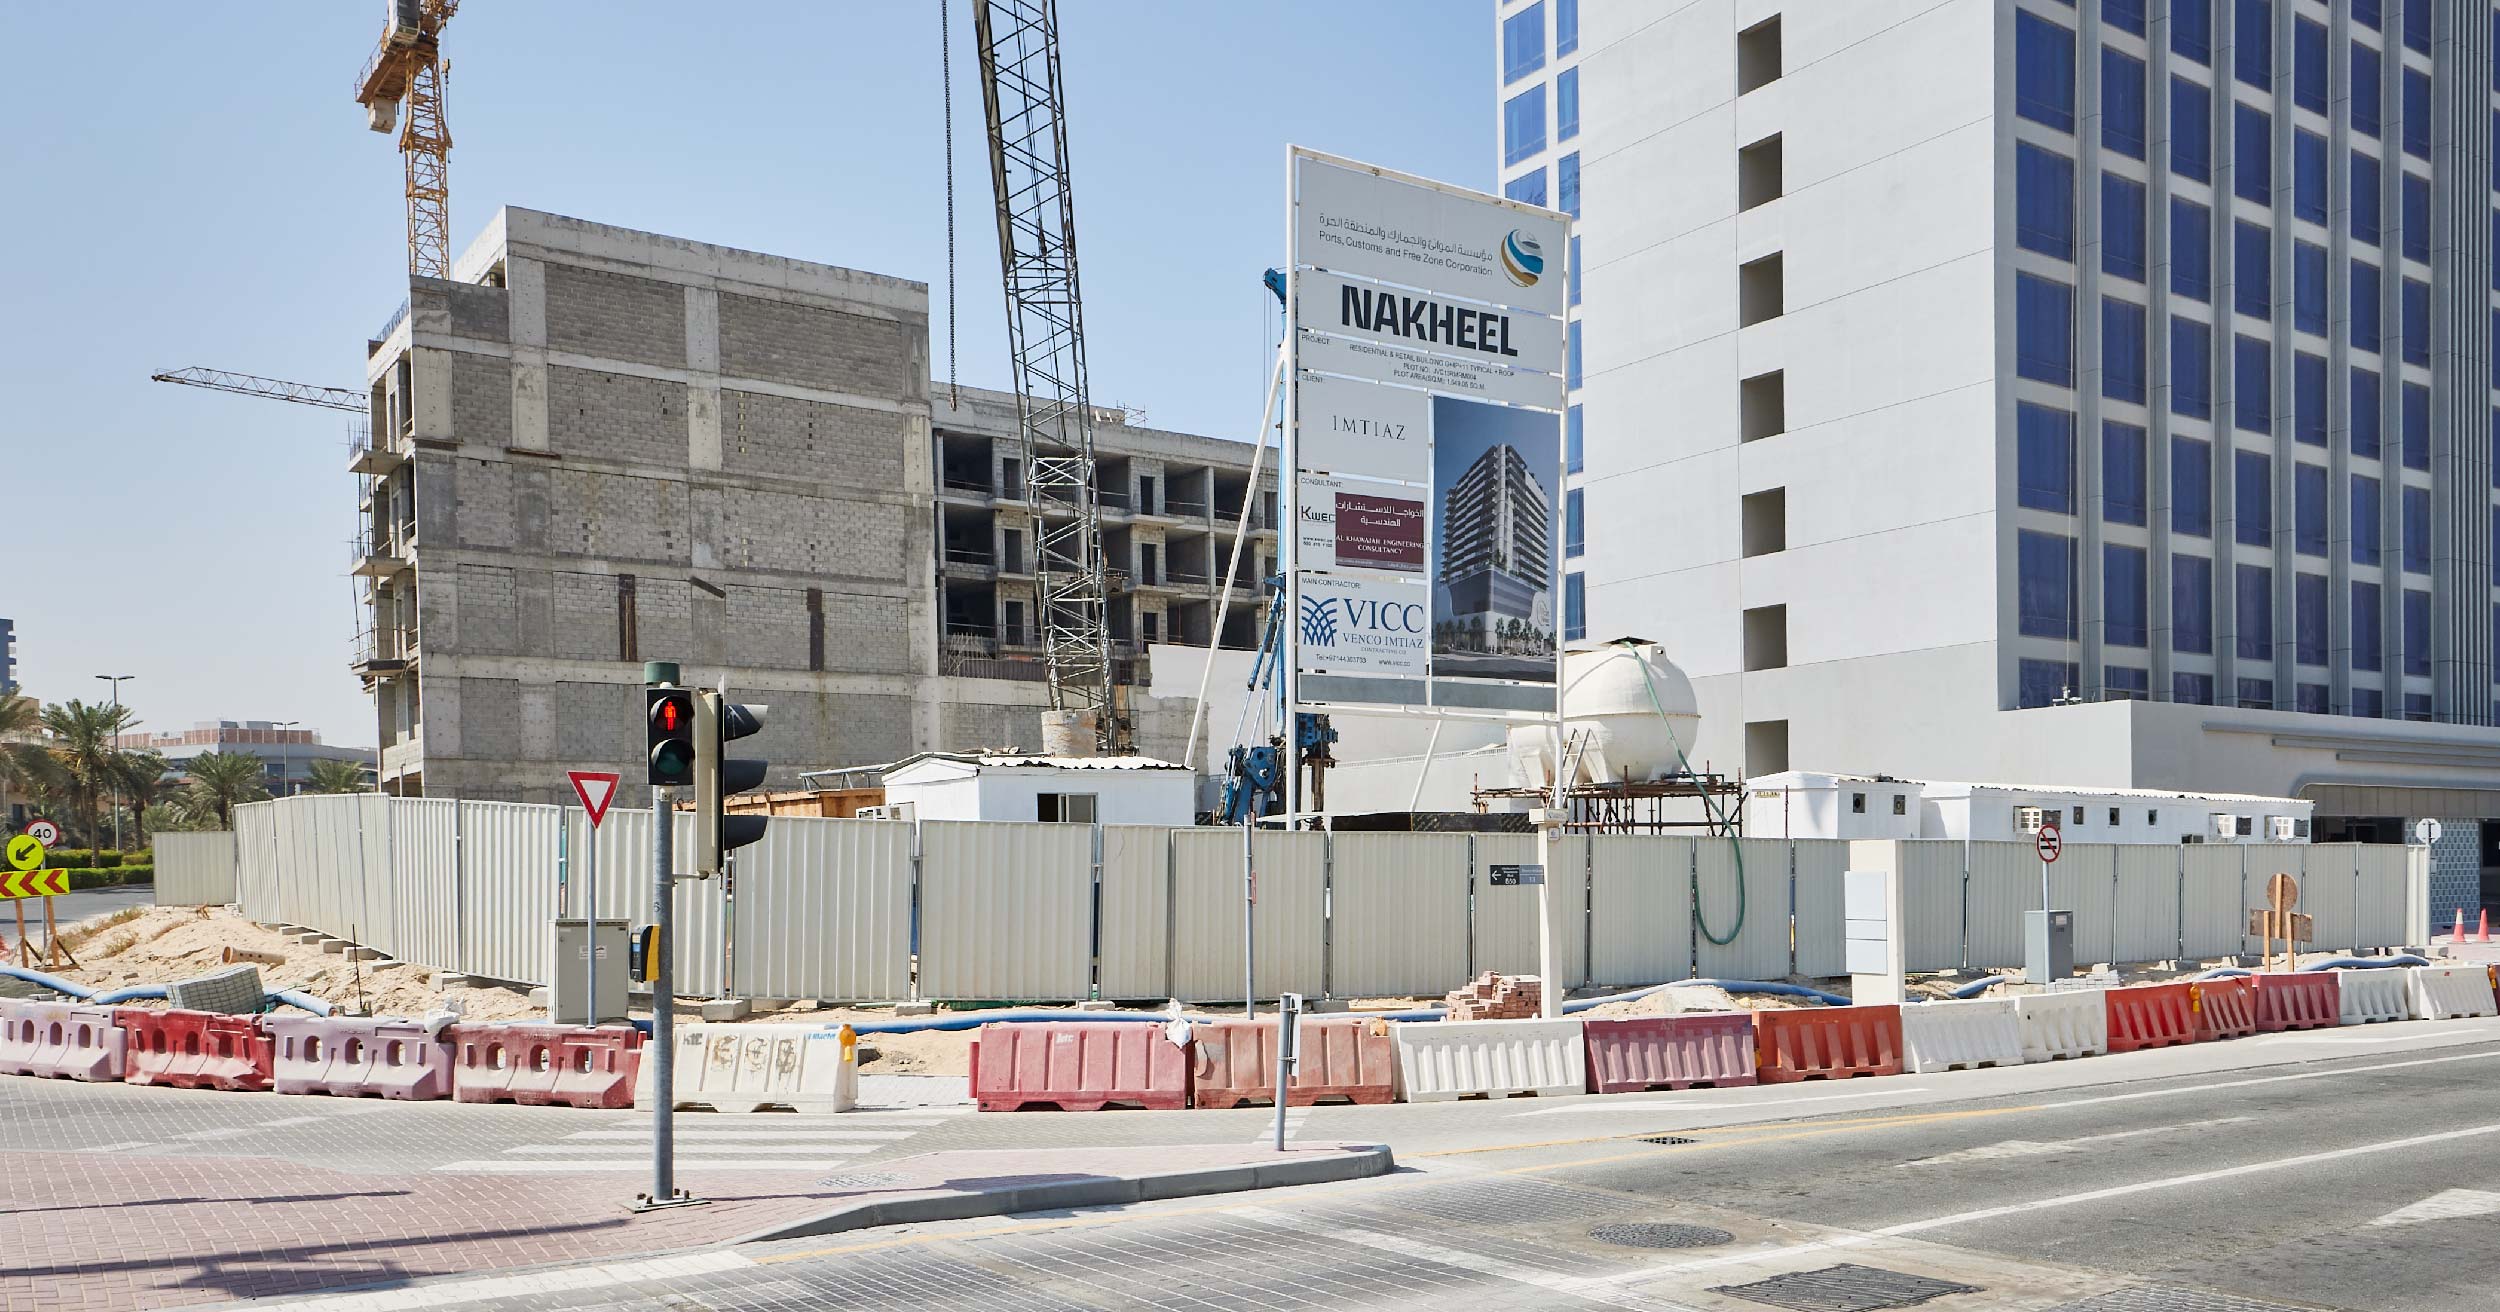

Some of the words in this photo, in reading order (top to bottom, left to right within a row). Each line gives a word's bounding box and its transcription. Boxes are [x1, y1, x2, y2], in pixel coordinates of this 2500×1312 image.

[1319, 212, 1343, 228] الحرة
[1344, 218, 1386, 240] والمنطقة
[1387, 229, 1427, 251] والجمارك
[1319, 230, 1345, 246] Ports,
[1346, 236, 1383, 254] Customs
[1385, 245, 1401, 258] and
[1403, 249, 1421, 263] Free
[1423, 254, 1444, 268] Zone
[1445, 259, 1493, 276] Corporation
[1459, 244, 1493, 263] مؤسسة
[1342, 284, 1518, 357] NAKHEEL
[1349, 343, 1388, 358] RESIDENTIAL
[1396, 352, 1415, 362] RETAIL
[1416, 354, 1444, 366] BUILDING
[1393, 370, 1409, 378] PLOT
[1403, 362, 1419, 371] PLOT
[1333, 415, 1405, 440] IMTIAZ
[1336, 534, 1344, 542] AL
[1357, 544, 1404, 555] CONSULTANCY
[1301, 577, 1318, 585] MAIN
[1343, 598, 1424, 634] VICC
[1343, 632, 1382, 646] VENCO
[1385, 636, 1424, 649] IMTIAZ
[34, 828, 51, 838] 40
